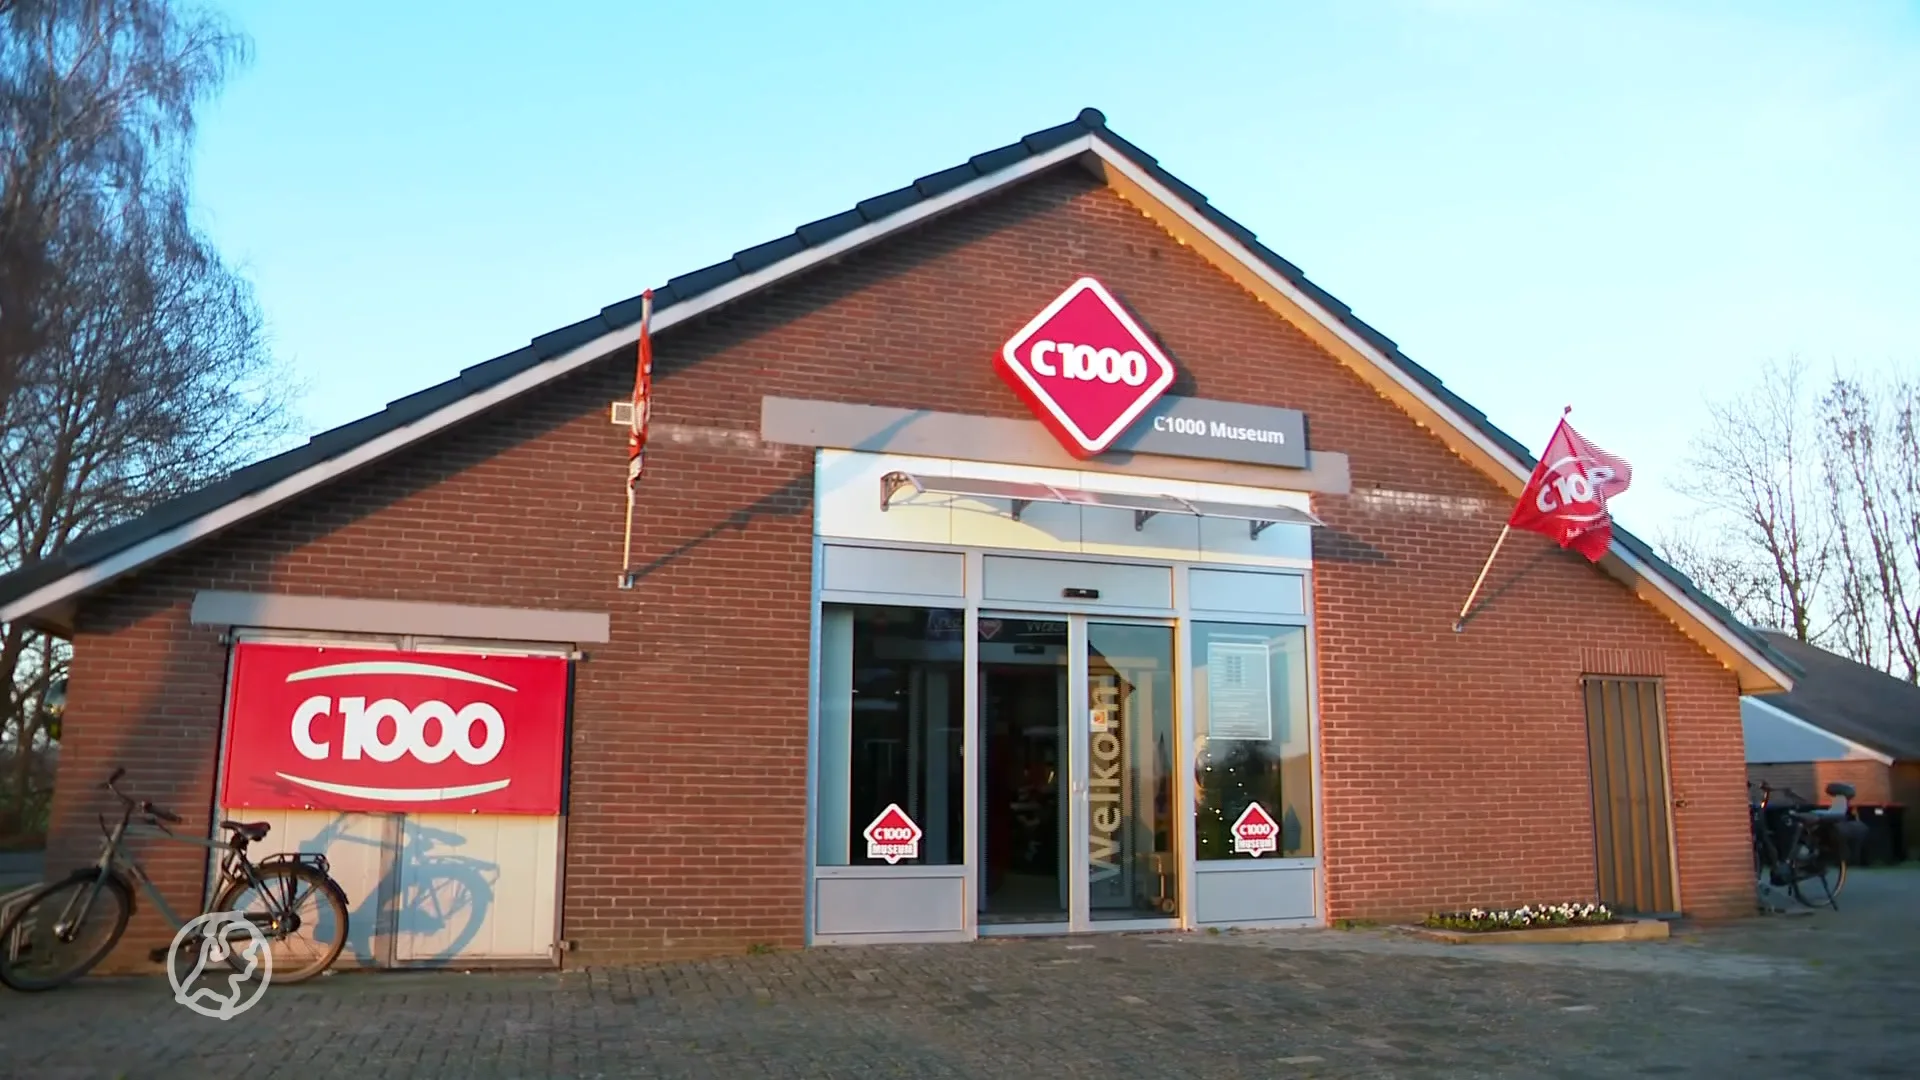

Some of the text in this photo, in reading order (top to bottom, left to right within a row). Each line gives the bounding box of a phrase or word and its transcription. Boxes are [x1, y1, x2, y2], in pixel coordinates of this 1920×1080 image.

[1030, 340, 1148, 387] C1000
[1153, 415, 1285, 445] C1000 Museum
[291, 695, 506, 765] C1000
[873, 827, 912, 841] C1000
[1239, 823, 1271, 836] C1000
[872, 843, 913, 855] MUSEUM
